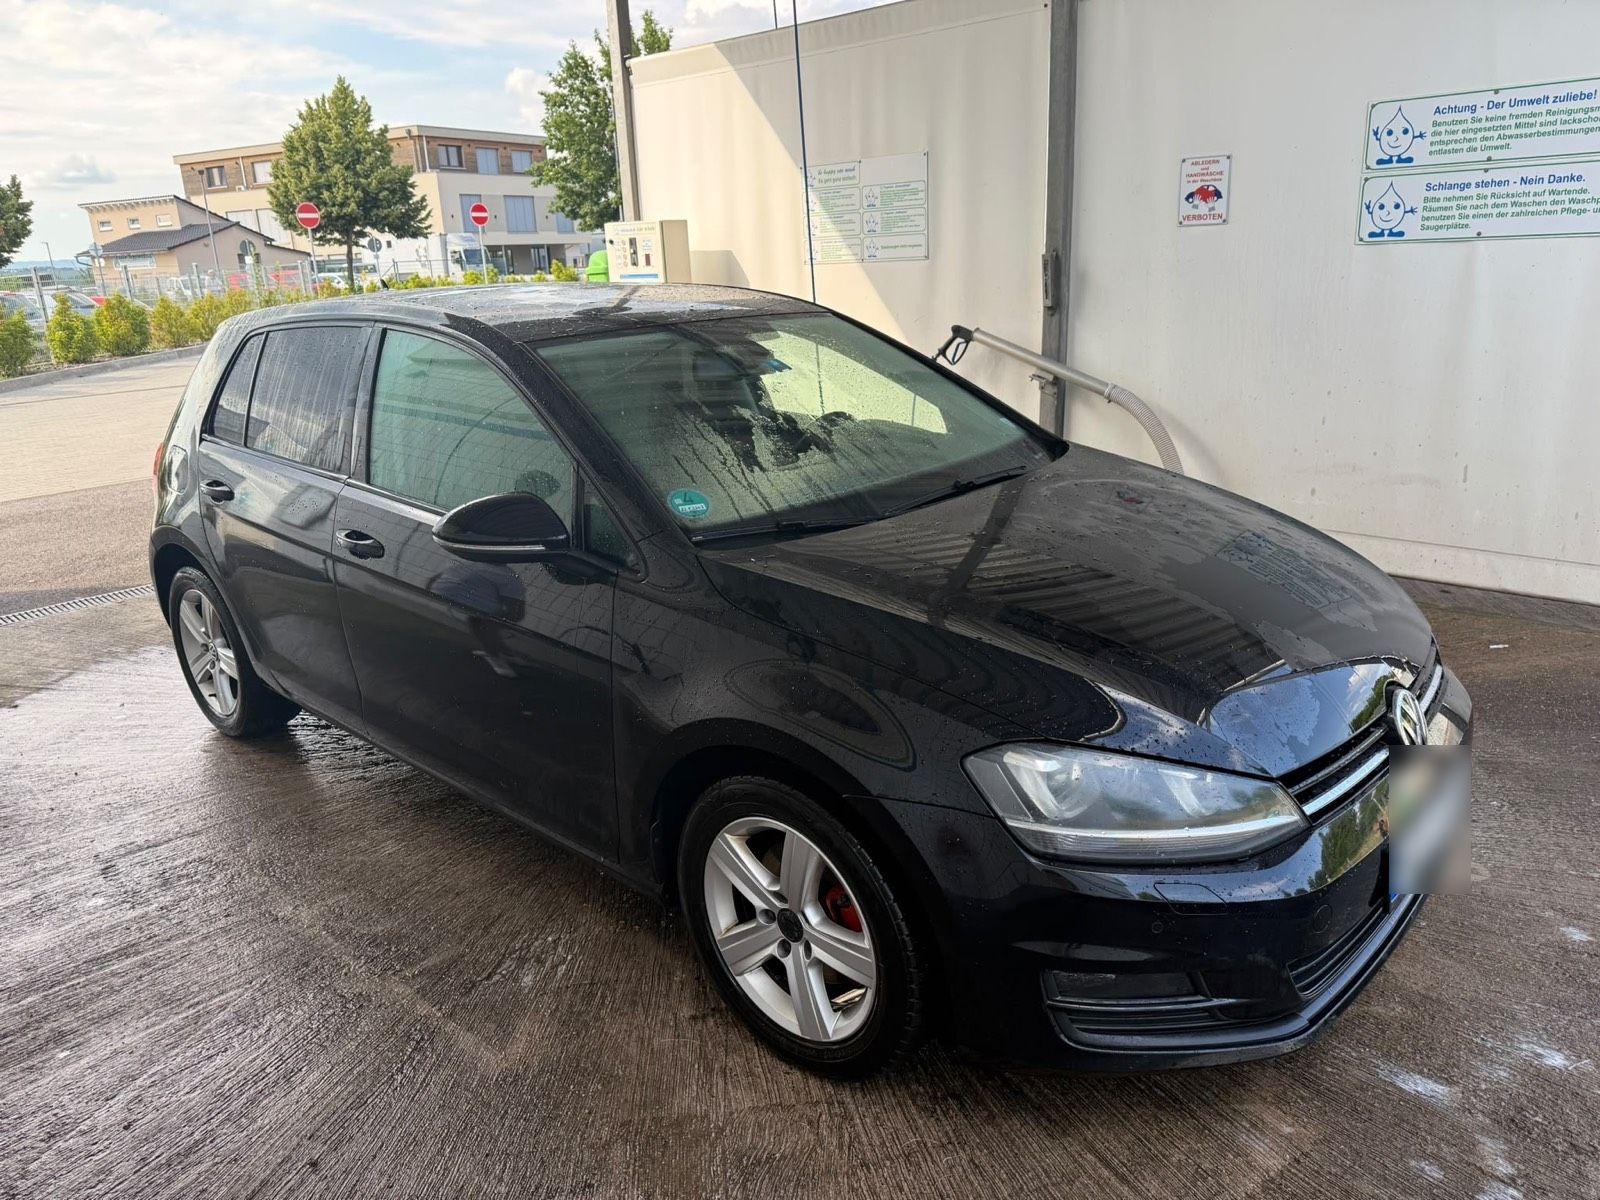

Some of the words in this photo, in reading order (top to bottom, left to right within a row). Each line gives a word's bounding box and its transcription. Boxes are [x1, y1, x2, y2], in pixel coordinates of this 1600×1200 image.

[1433, 104, 1477, 115] Achtung
[1487, 100, 1506, 110] Der
[1508, 95, 1549, 108] Umwelt
[1552, 89, 1598, 103] zuliebe!
[1432, 119, 1468, 128] Benutzen
[1470, 116, 1483, 124] Sie
[1485, 114, 1507, 123] keine
[1509, 111, 1543, 120] fremden
[1444, 128, 1460, 136] hier
[1461, 124, 1512, 134] eingesetzten
[1514, 120, 1537, 130] Mittel
[1539, 118, 1558, 127] sind
[1559, 115, 1600, 125] lackscho
[1428, 147, 1464, 156] entlasten
[1466, 145, 1478, 153] die
[1480, 142, 1512, 152] Umwelt.
[1429, 136, 1478, 147] entsprechen
[1425, 181, 1472, 192] Schlange
[1474, 178, 1510, 188] stehen
[1520, 175, 1544, 186] Nein
[1547, 172, 1586, 184] Danke.
[1423, 196, 1441, 204] Bitte
[1443, 195, 1474, 203] nehmen
[1490, 190, 1531, 200] Rücksicht
[1532, 189, 1546, 198] auf
[1548, 187, 1590, 196] Wartende.
[1422, 205, 1453, 213] Räumen
[1455, 203, 1468, 211] Sie
[1469, 202, 1489, 210] nach
[1510, 199, 1547, 208] Waschen
[1549, 198, 1566, 206] den
[1182, 212, 1223, 221] VERBOTEN
[1421, 214, 1456, 222] benutzen
[1458, 212, 1470, 220] Sie
[1510, 208, 1558, 217] zahlreichen
[1560, 207, 1590, 216] Pflege-
[1420, 222, 1471, 231] Saugerplätze.
